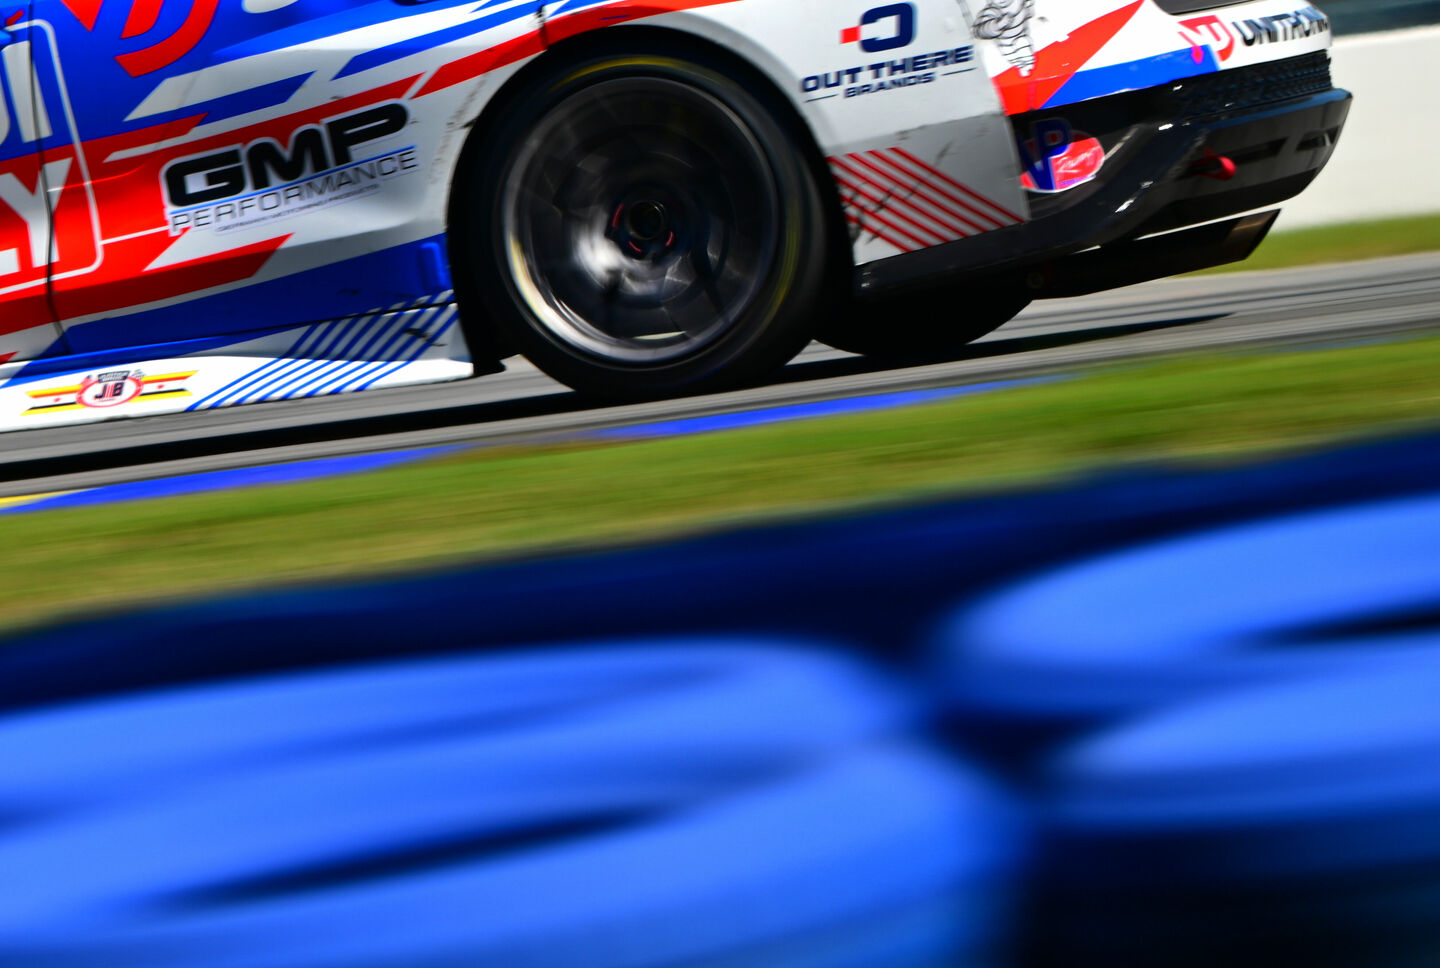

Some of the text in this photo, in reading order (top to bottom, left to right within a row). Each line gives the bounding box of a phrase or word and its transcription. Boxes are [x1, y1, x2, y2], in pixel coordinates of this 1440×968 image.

[800, 44, 975, 93] OUT THERE
[843, 72, 936, 99] BRANDS
[164, 102, 408, 208] GMP
[170, 148, 419, 233] PERFORMANCE
